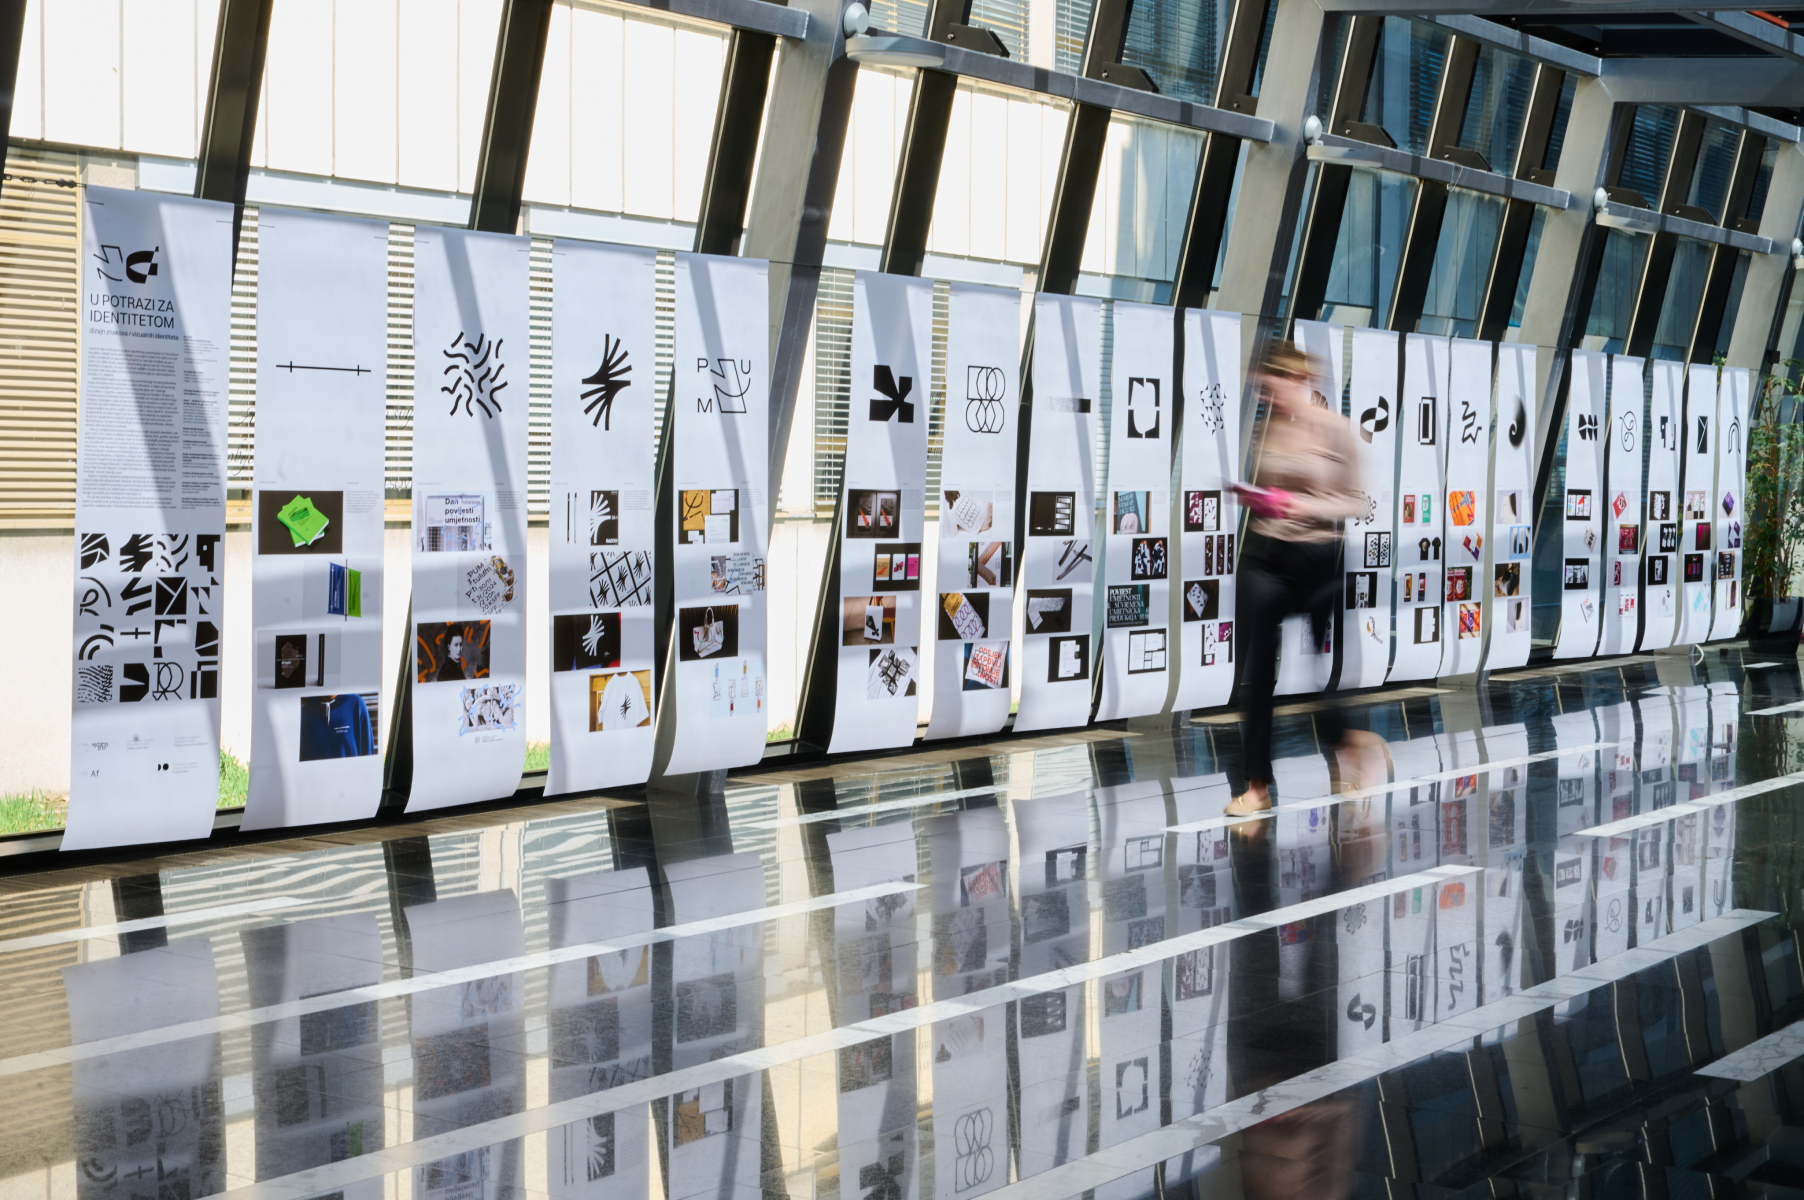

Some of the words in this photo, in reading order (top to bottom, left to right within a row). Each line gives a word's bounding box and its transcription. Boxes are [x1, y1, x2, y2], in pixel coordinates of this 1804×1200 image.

[90, 293, 99, 306] U
[102, 294, 156, 311] POTRAZI
[157, 299, 175, 313] ZA
[90, 309, 175, 329] IDENTITETOM
[89, 327, 106, 336] dizajn
[106, 328, 128, 337] znakova
[132, 330, 154, 339] vizualnih
[155, 332, 179, 341] identiteta
[697, 358, 709, 373] P
[740, 359, 751, 374] U
[697, 398, 712, 413] M
[445, 506, 474, 515] povijesti
[444, 515, 481, 525] umjetnosti
[467, 562, 485, 578] PUM
[979, 646, 1002, 660] ODSJEK
